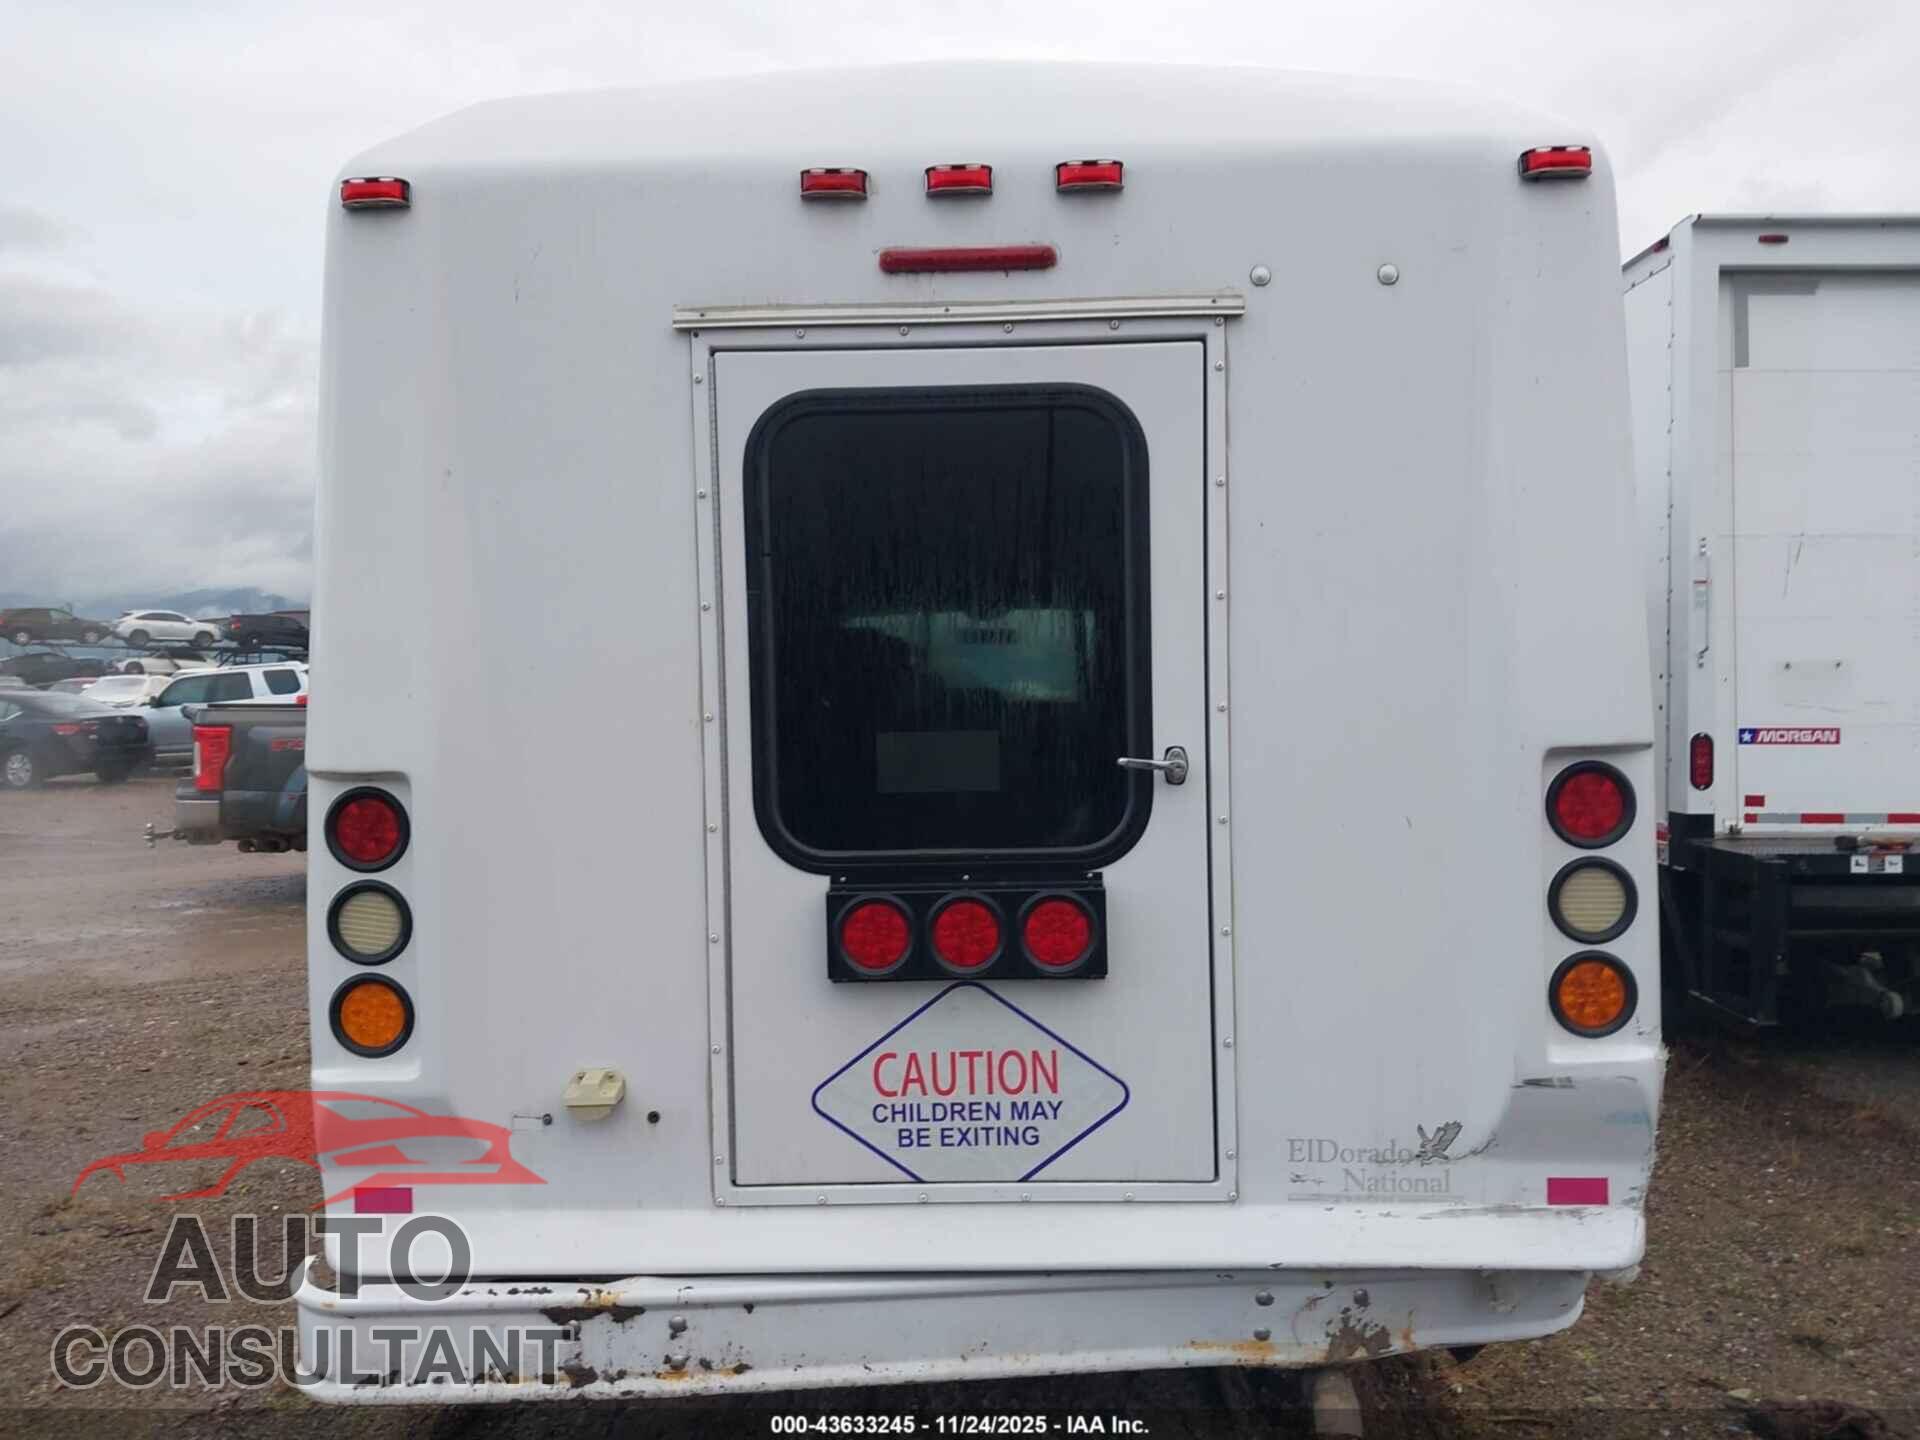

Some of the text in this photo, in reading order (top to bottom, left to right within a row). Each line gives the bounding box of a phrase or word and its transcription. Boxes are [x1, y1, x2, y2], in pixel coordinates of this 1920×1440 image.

[1756, 729, 1838, 743] MORGAN
[872, 1049, 1059, 1098] CAUTION
[872, 1100, 1064, 1124] CHILDREN MAY
[897, 1125, 1041, 1148] BE EXITING
[1287, 1138, 1416, 1163] ElDorado
[1343, 1167, 1450, 1193] National
